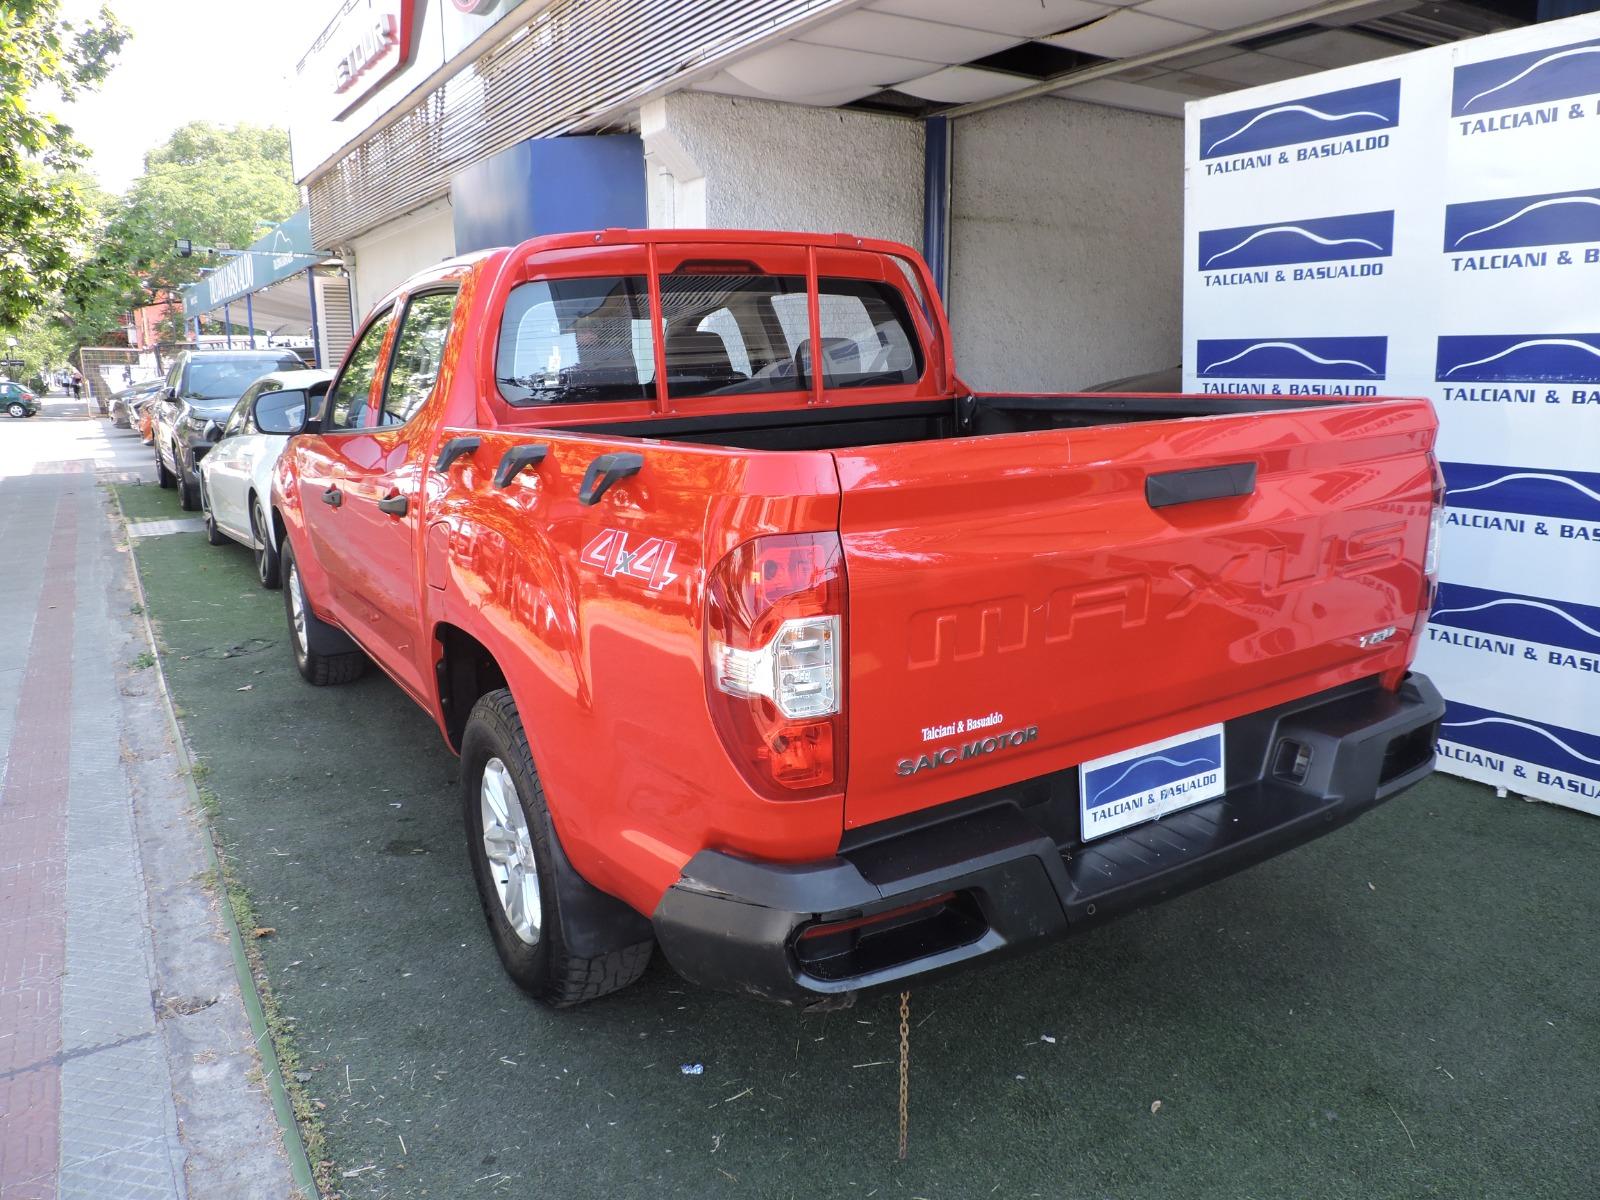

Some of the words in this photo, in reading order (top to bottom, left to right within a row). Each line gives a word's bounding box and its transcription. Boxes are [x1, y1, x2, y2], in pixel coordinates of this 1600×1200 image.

[1460, 106, 1559, 136] TALCIANI
[1567, 103, 1585, 120] &
[1205, 154, 1272, 176] TALCIANI
[1278, 151, 1289, 164] &
[1296, 134, 1390, 162] BASUALDO
[1204, 271, 1269, 287] TALCIANI
[1275, 270, 1286, 282] &
[1293, 262, 1383, 281] BASUALDO
[1451, 251, 1547, 272] TALCIANI
[1556, 250, 1573, 265] &
[1202, 382, 1266, 395] TALCIANI
[1272, 383, 1282, 396] &
[1443, 387, 1536, 403] TALCIANI
[1545, 390, 1560, 404] &
[1444, 511, 1525, 533] ALCIANI
[1534, 521, 1549, 536] &
[580, 527, 679, 591] 4x4
[1428, 628, 1515, 656] TALCIANI
[1524, 646, 1538, 661] &
[921, 721, 956, 741] Talciani
[957, 720, 965, 734] &
[966, 711, 1003, 732] Basualdo
[896, 746, 958, 776] SAIC
[960, 725, 1039, 761] MOTOR
[1435, 743, 1505, 772] ALCIANI
[1513, 764, 1527, 779] &
[1091, 796, 1143, 823] TALCIANI
[1147, 793, 1156, 805] &
[1160, 773, 1217, 801] BASUALDO
